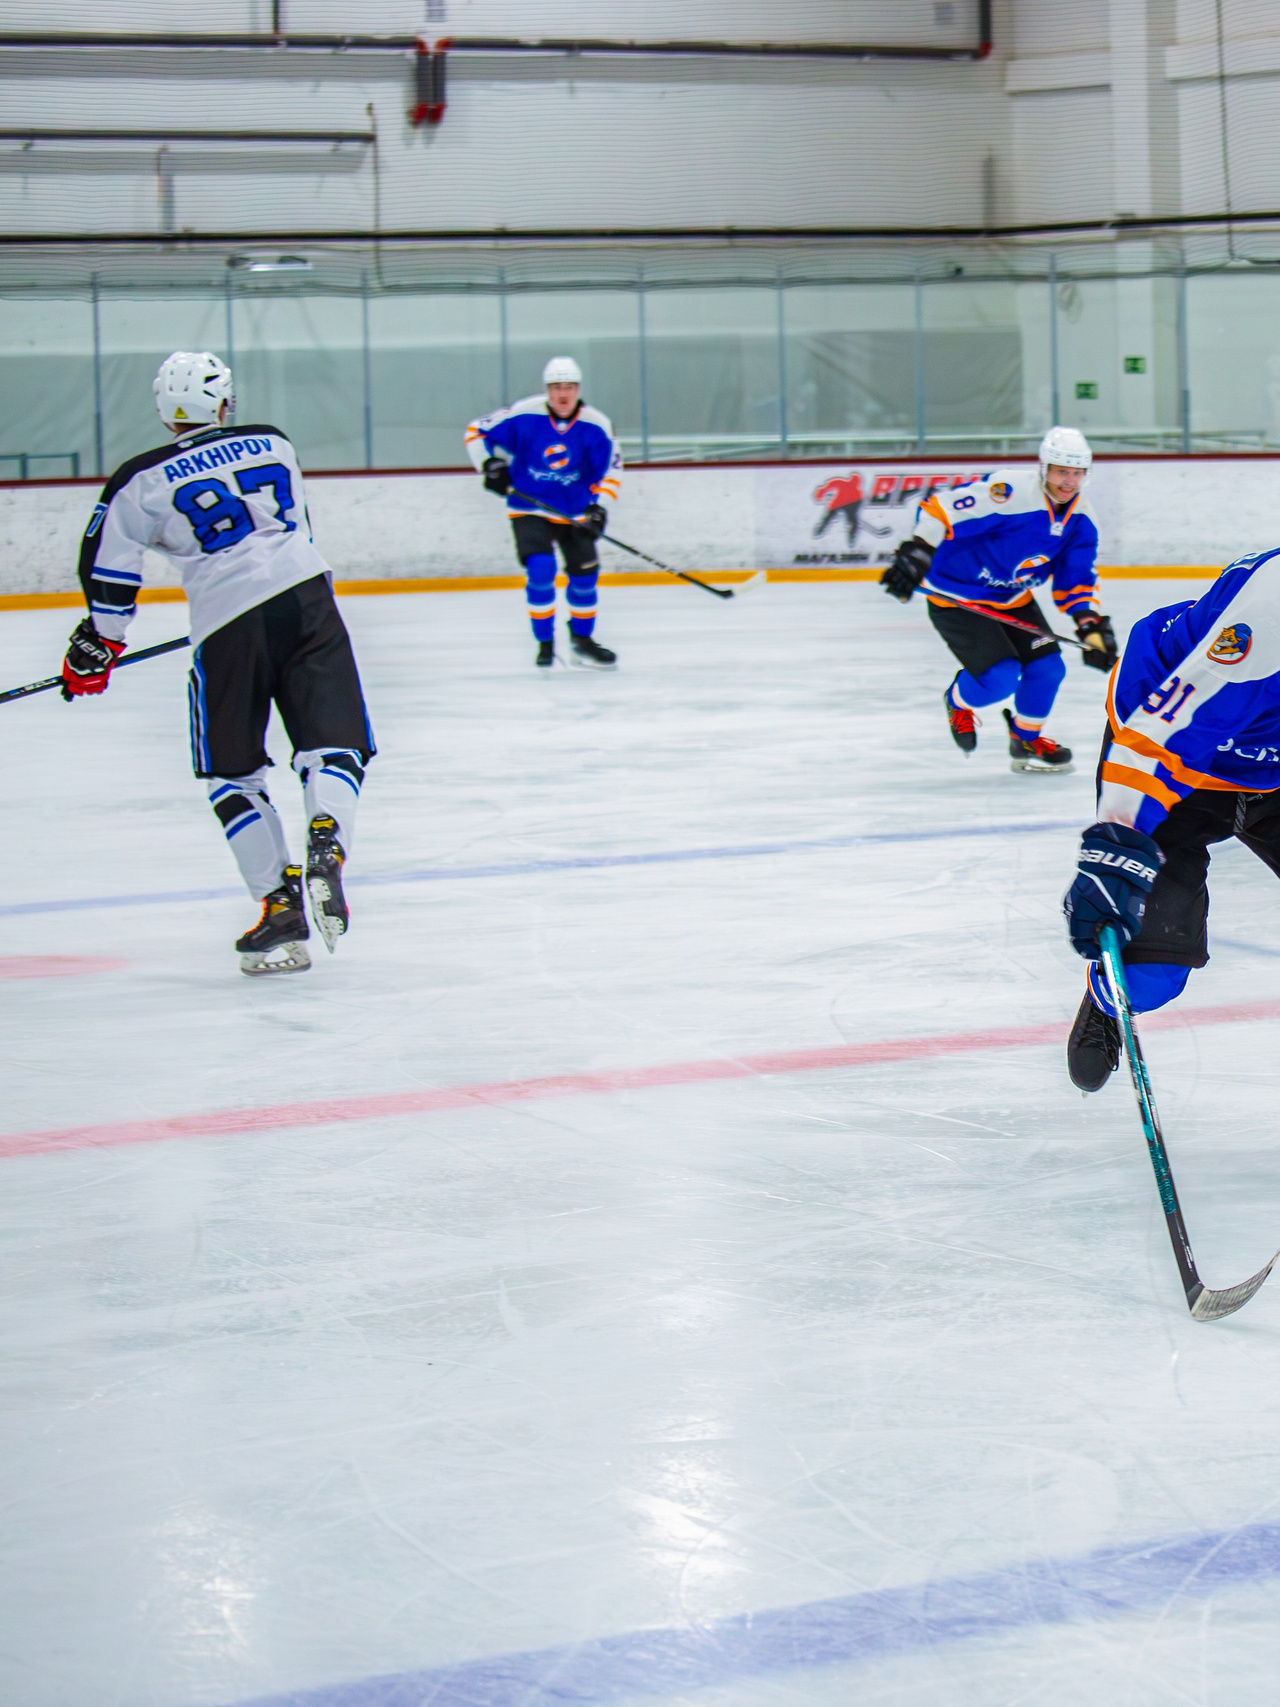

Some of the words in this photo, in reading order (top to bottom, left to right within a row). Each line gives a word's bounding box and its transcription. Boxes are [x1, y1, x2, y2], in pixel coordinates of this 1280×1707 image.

[163, 438, 272, 483] ARKHIPOV
[172, 463, 297, 554] 87
[953, 496, 976, 510] 8
